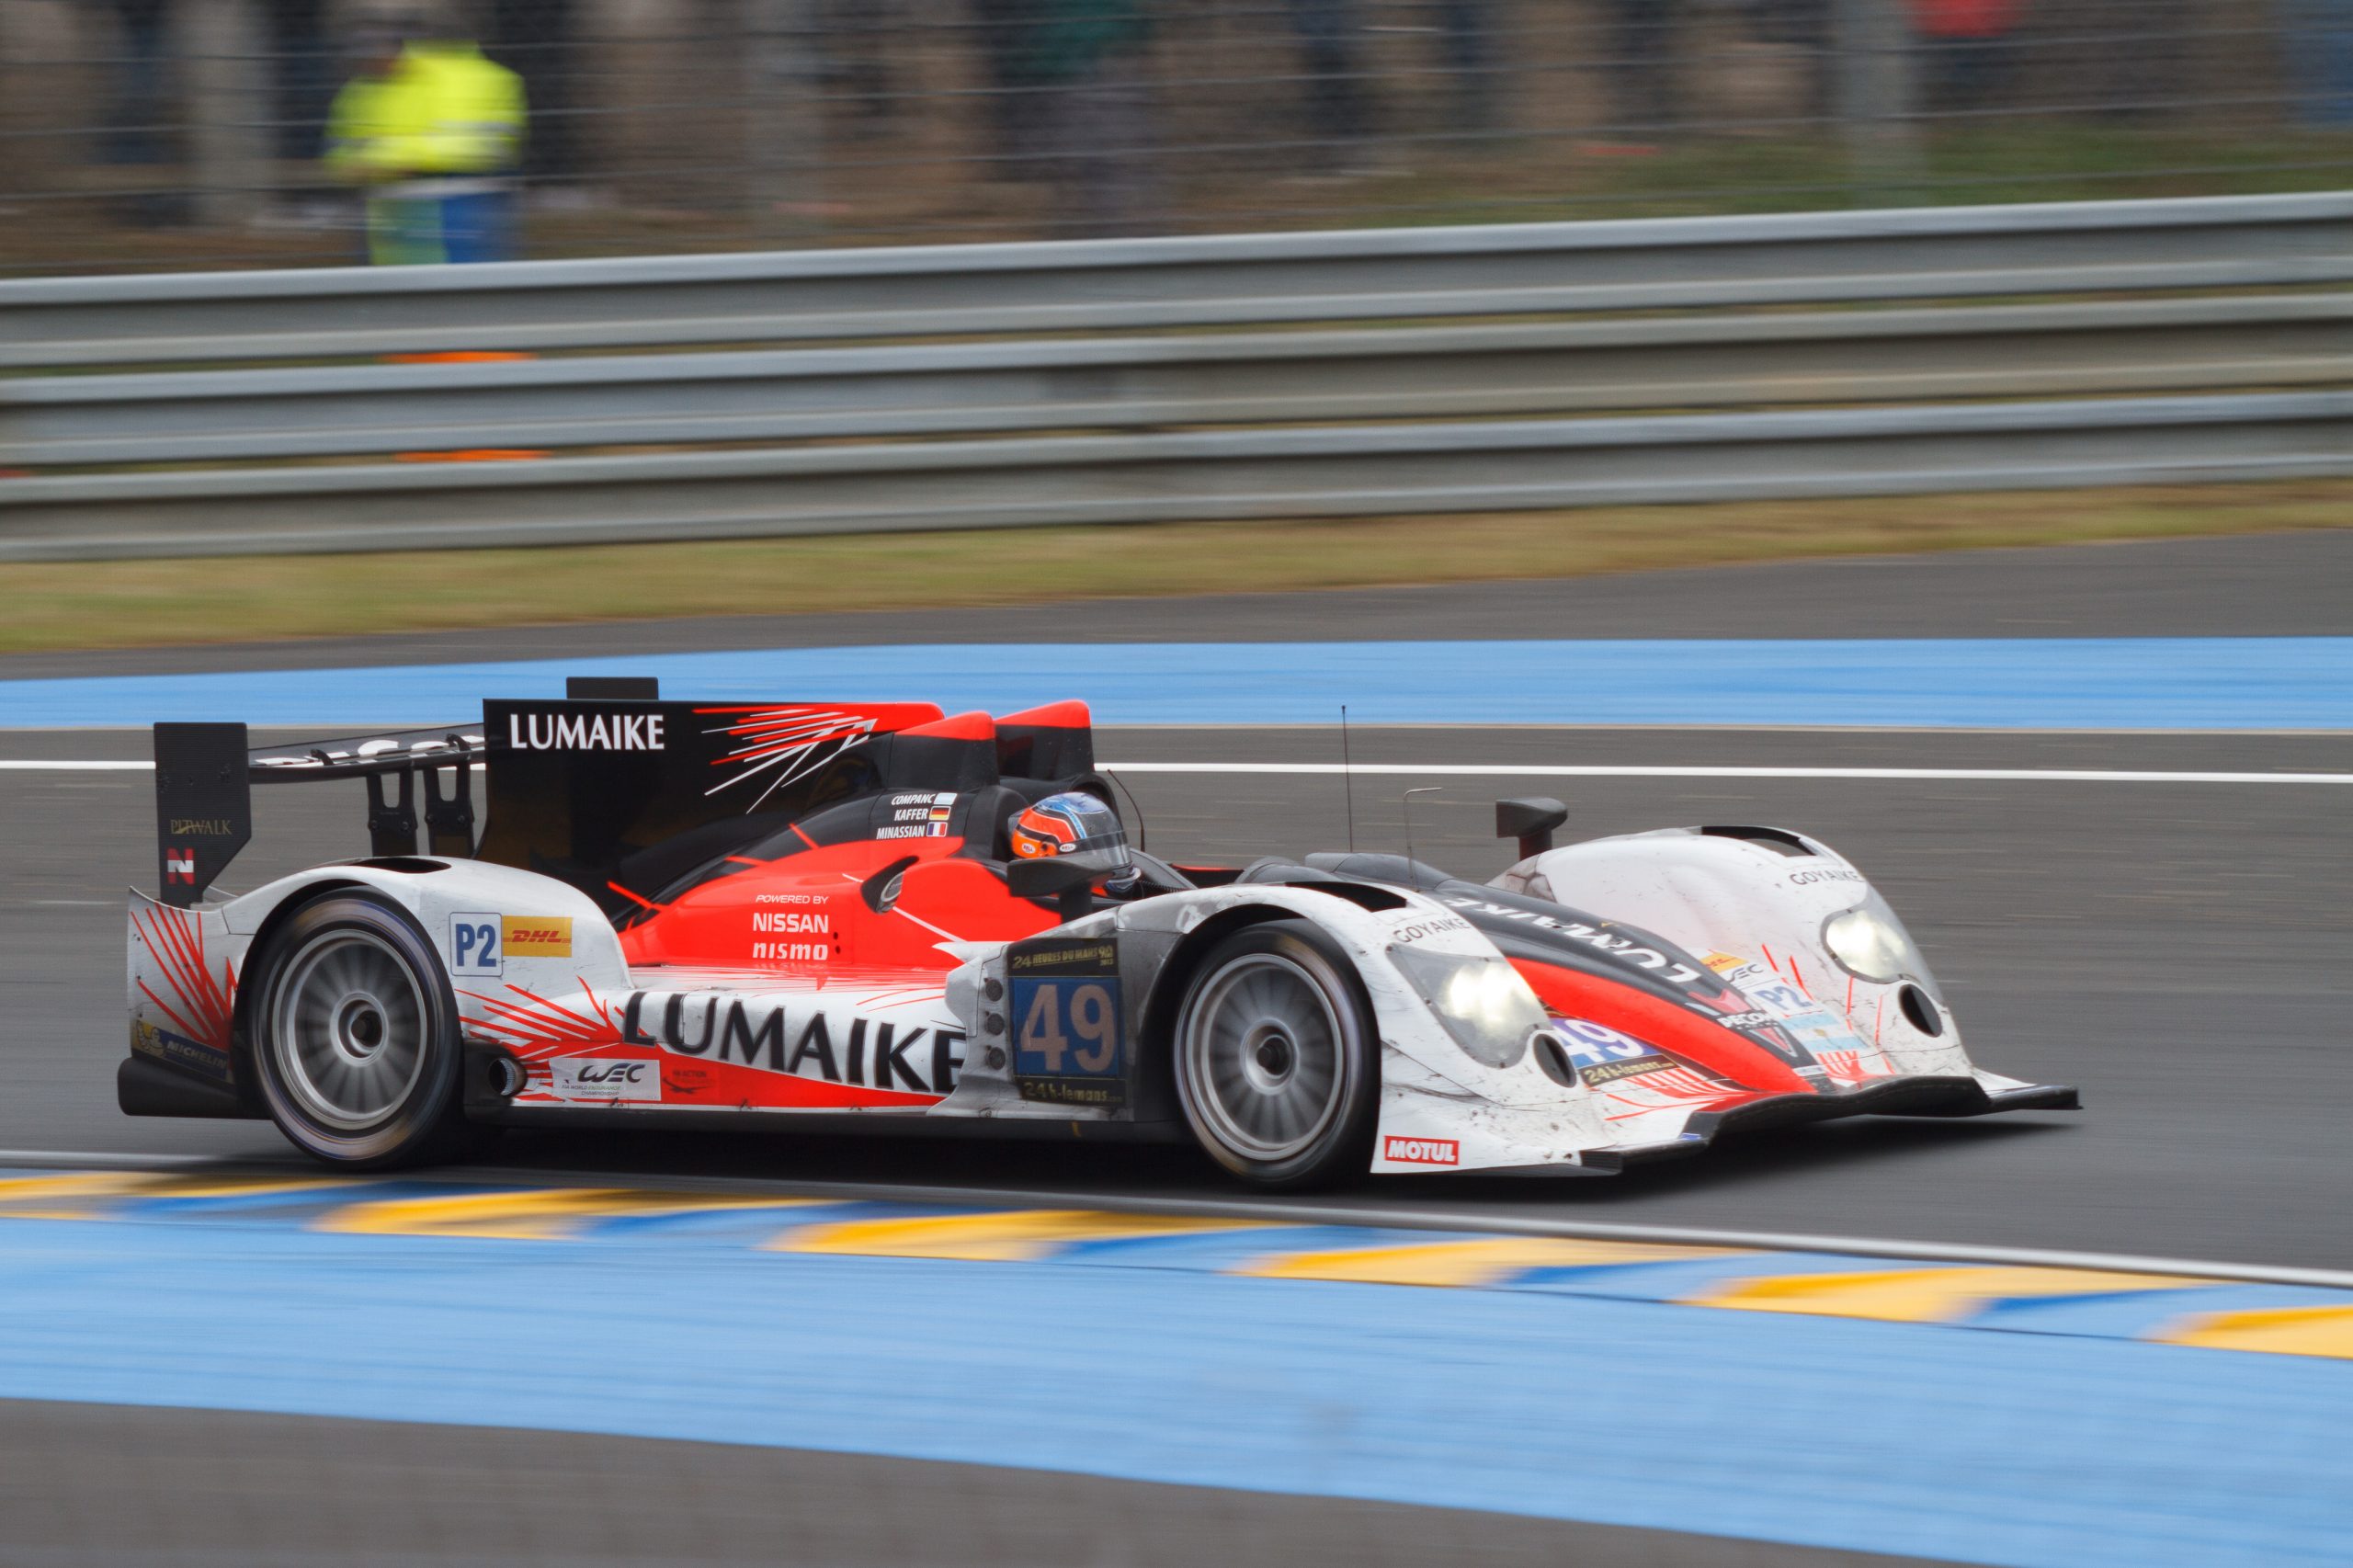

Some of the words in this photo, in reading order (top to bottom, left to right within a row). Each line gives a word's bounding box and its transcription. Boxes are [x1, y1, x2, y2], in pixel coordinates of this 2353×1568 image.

[510, 713, 665, 750] LUMAIKE
[891, 793, 936, 805] COMPANC
[894, 809, 928, 821] KAFFER
[876, 825, 926, 840] MINASSIAN
[756, 894, 811, 904] POWERED
[813, 895, 829, 904] BY
[753, 912, 829, 934] NISSAN
[1392, 918, 1471, 943] GOYAIKE
[455, 923, 497, 968] P2
[511, 929, 563, 943] DHL
[1013, 956, 1031, 969] 24
[1032, 951, 1062, 964] HEURES
[1063, 949, 1074, 961] DU
[1753, 985, 1813, 1011] P2
[1020, 983, 1116, 1074] 49
[1552, 1019, 1644, 1063] 49
[167, 1040, 227, 1069] MICHELIN
[577, 1062, 646, 1083] WEC
[1387, 1140, 1456, 1162] MOTUL
